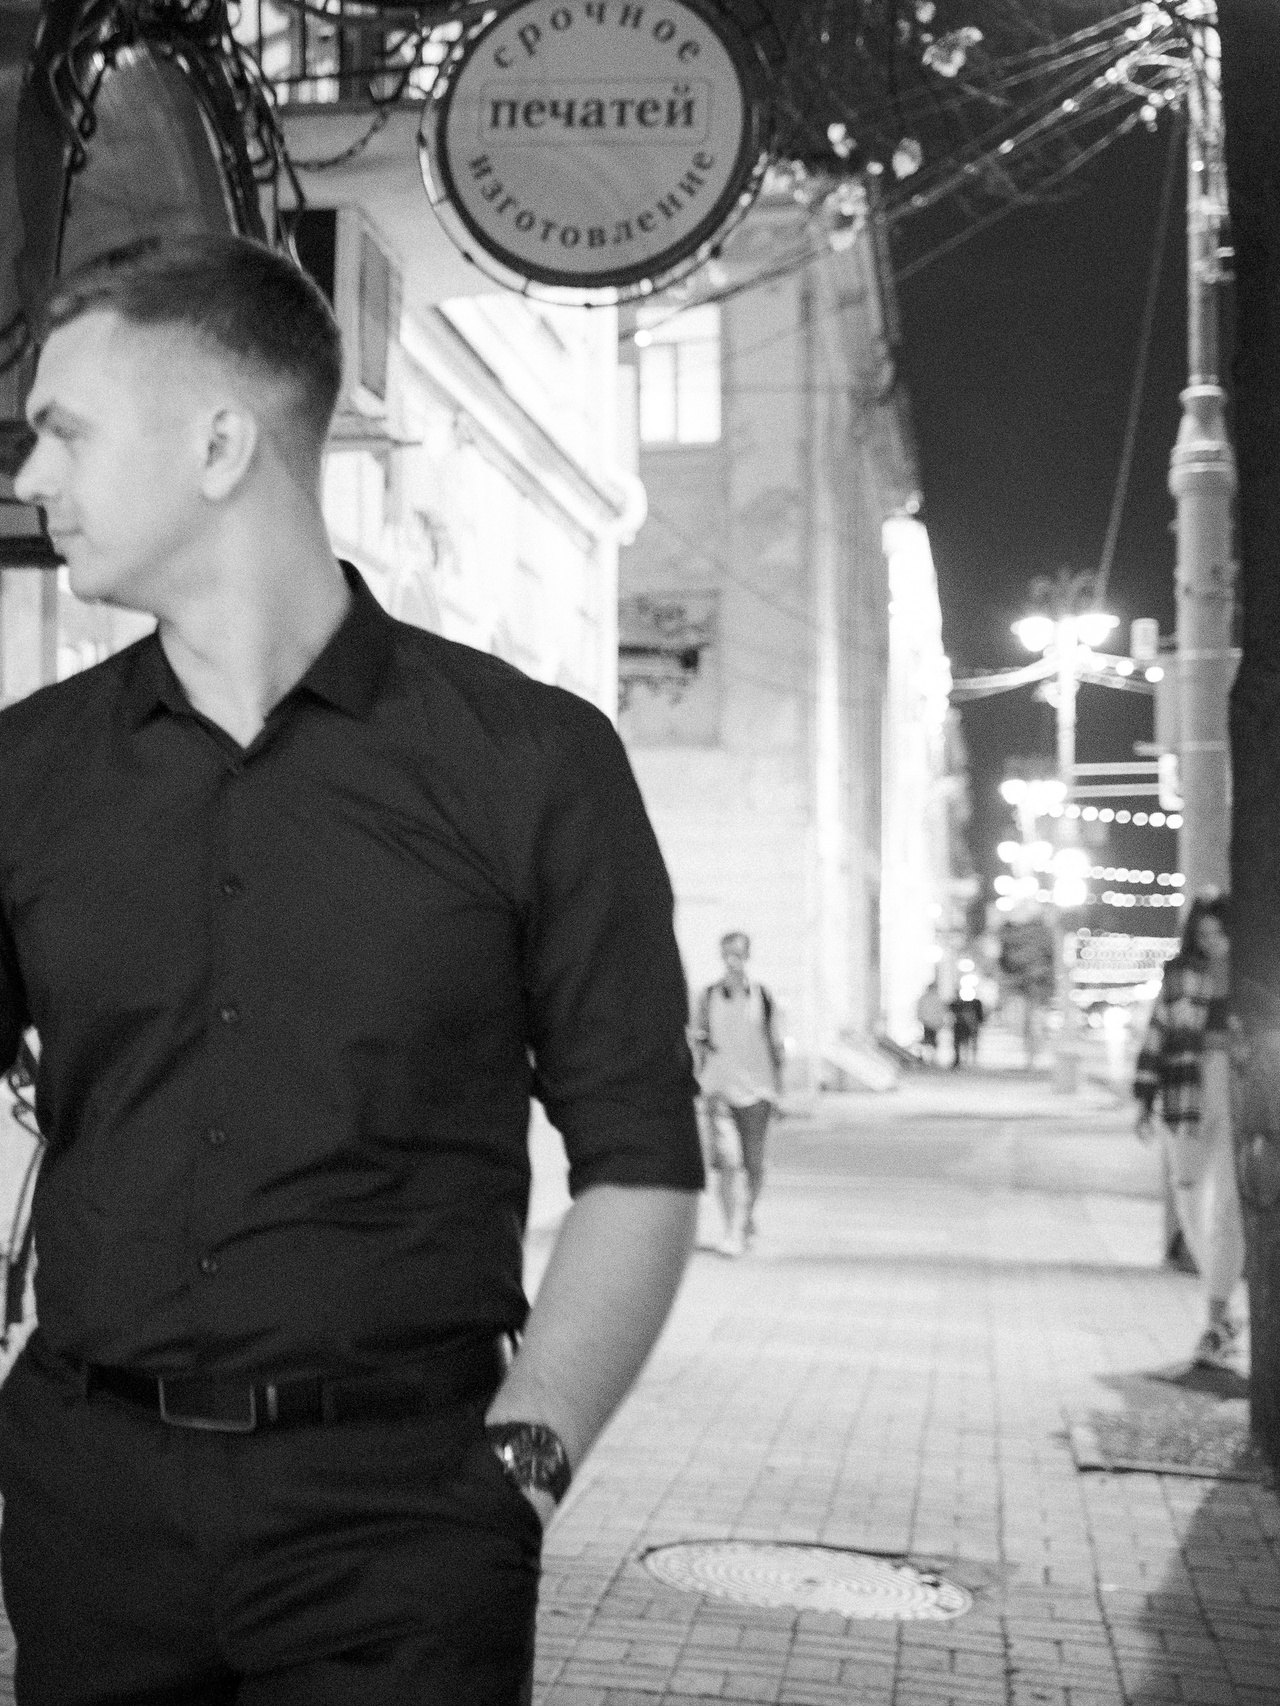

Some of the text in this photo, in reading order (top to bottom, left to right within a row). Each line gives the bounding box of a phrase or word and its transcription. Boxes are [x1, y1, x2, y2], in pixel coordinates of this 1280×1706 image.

[493, 2, 701, 68] срочное
[489, 83, 696, 129] печатей
[468, 150, 715, 248] изготовление
